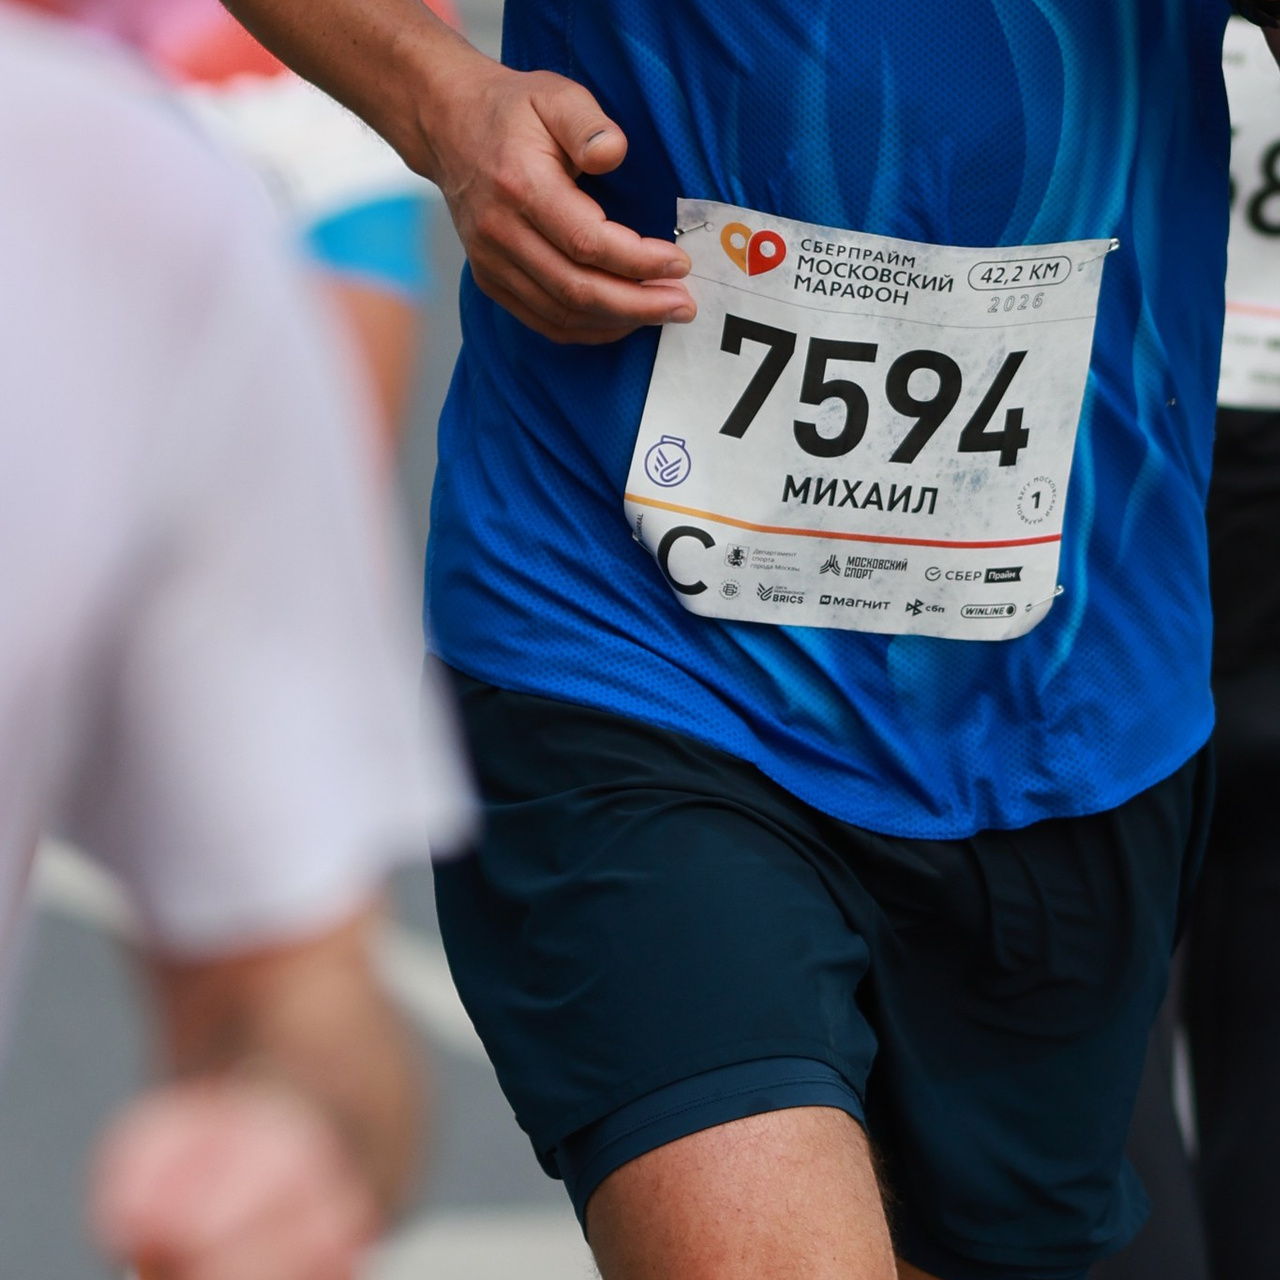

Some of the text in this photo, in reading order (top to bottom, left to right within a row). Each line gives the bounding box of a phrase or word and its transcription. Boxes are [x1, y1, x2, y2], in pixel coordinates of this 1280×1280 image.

[800, 238, 916, 269] СБЕРПРАЙМ
[797, 254, 954, 293] МОСКОВСКИЙ
[980, 266, 1023, 286] 42,2
[794, 274, 909, 306] МАРАФОН
[987, 292, 1045, 314] 2026
[718, 313, 1030, 468] 7594
[781, 476, 939, 516] МИХАИЛ
[1031, 490, 1041, 509] 1
[846, 555, 908, 572] МОСКОВСКИЙ
[844, 568, 874, 580] СПОРТ
[945, 570, 982, 582] СБЕР
[772, 593, 804, 605] BRICS
[964, 606, 1006, 616] WINLINE
